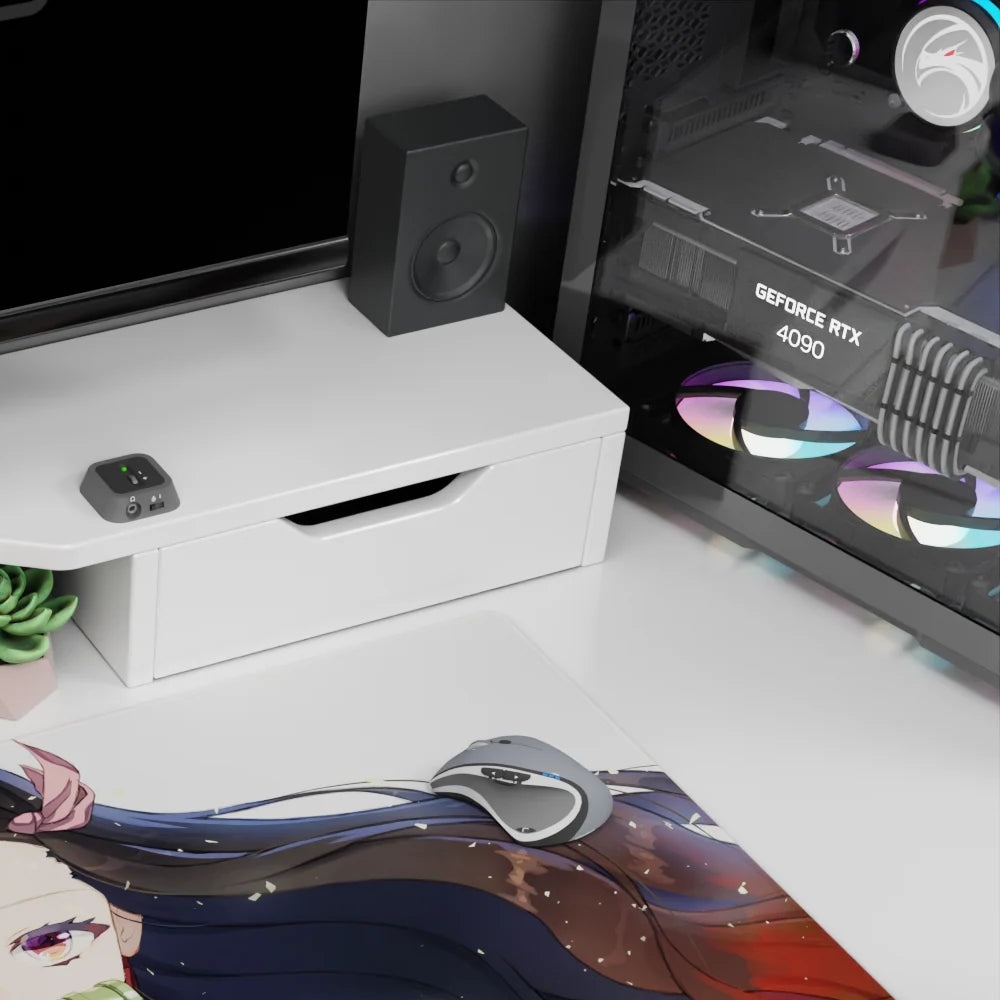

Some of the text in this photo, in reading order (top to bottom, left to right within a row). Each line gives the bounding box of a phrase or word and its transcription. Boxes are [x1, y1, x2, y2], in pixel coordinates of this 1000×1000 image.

[755, 282, 863, 347] GEFORCE RTX
[776, 324, 825, 360] 4090
